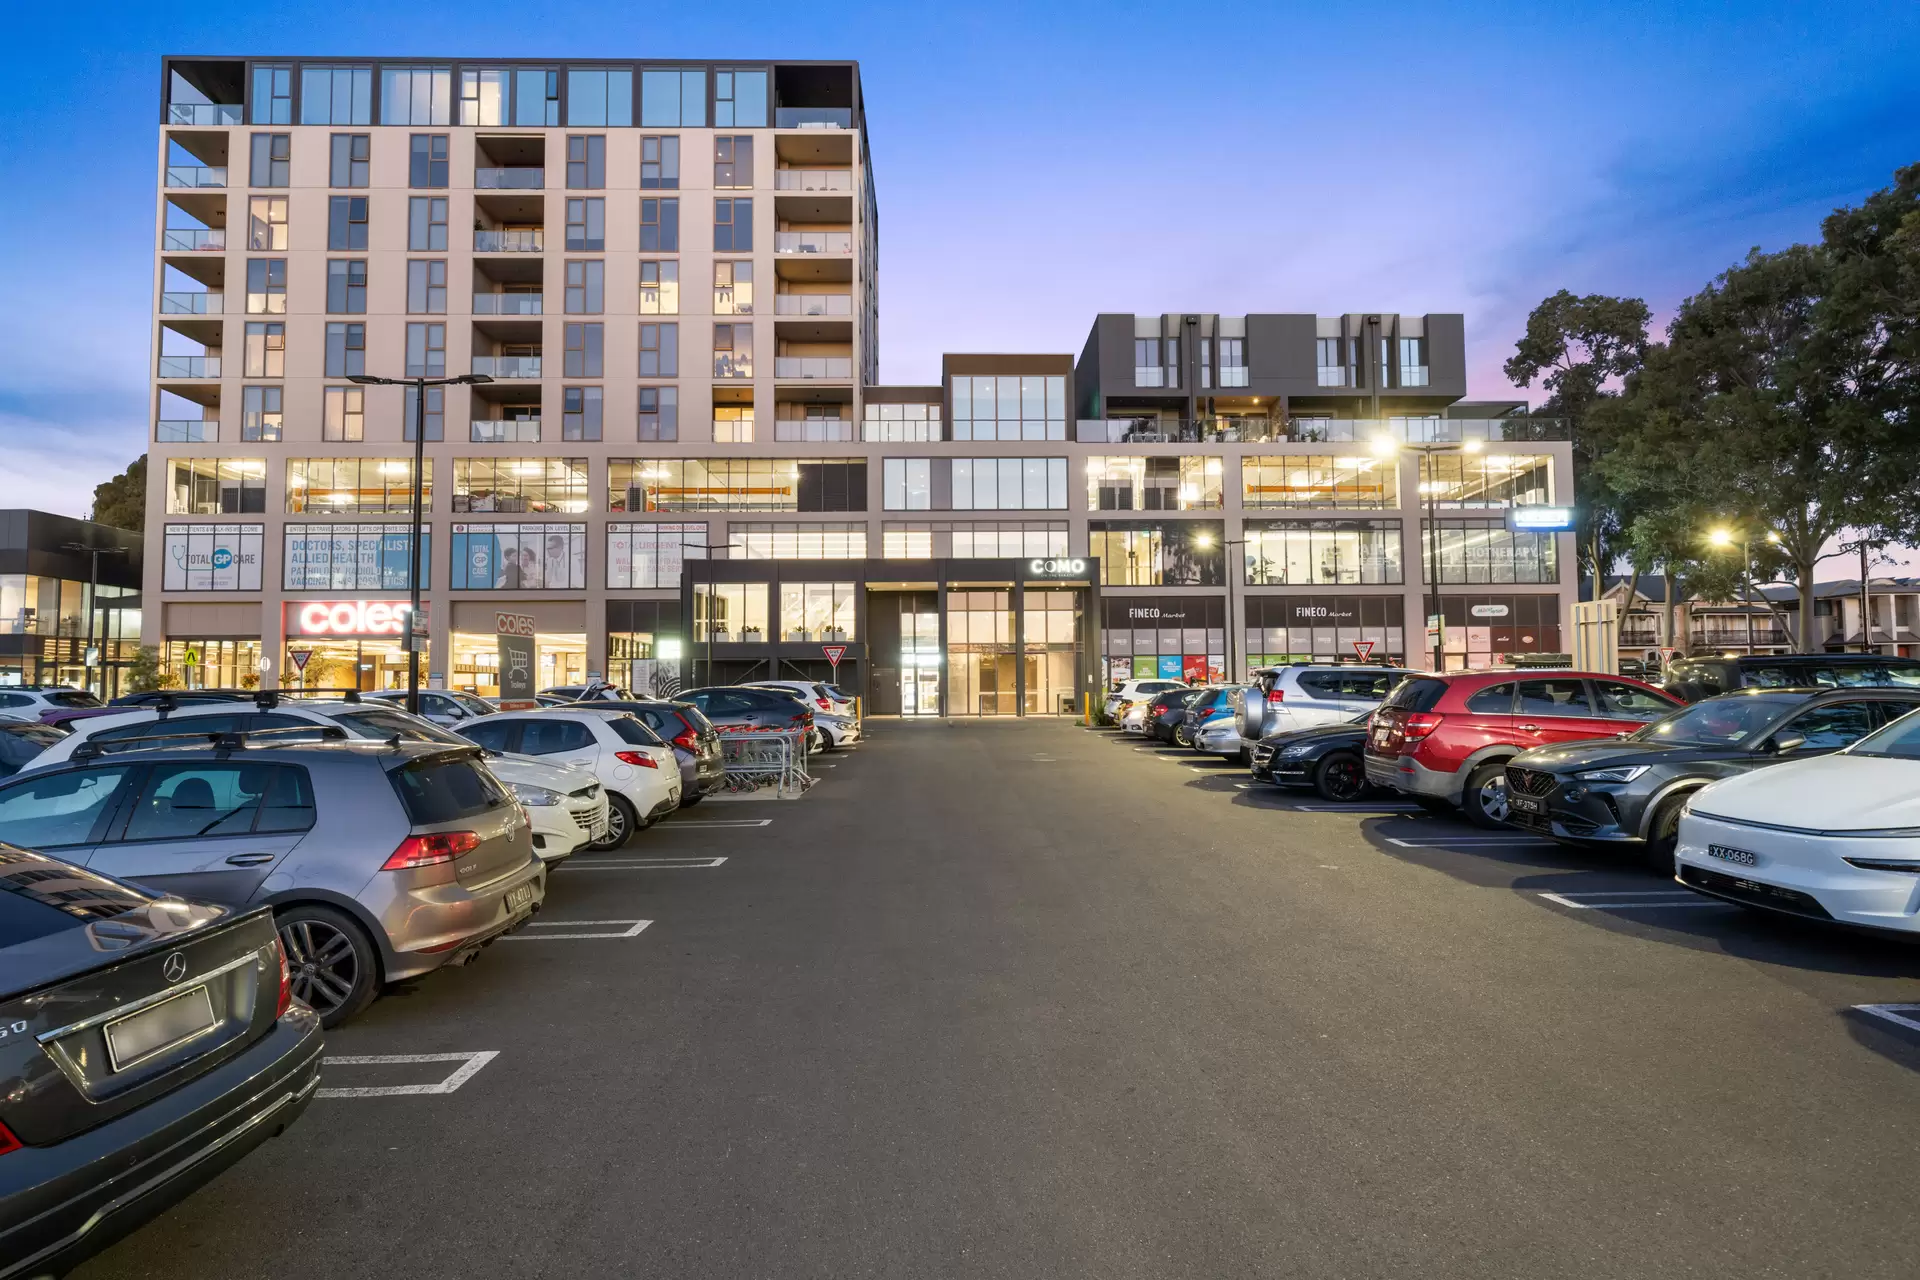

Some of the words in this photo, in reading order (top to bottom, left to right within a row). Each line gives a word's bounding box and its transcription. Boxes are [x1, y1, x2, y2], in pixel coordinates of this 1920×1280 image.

[292, 540, 345, 552] DOCTORS,
[472, 545, 489, 553] TOTAL
[185, 554, 211, 564] TOTAL
[214, 554, 231, 565] GP
[232, 554, 255, 564] CARE
[292, 553, 328, 563] ALLIED
[331, 553, 374, 563] HEALTH
[1031, 559, 1085, 573] COMO
[300, 600, 413, 633] coles
[1129, 608, 1160, 618] FINECO
[1296, 607, 1327, 617] FINECO
[497, 614, 534, 635] coles
[510, 681, 526, 690] Trolleys
[460, 864, 477, 874] GOLF
